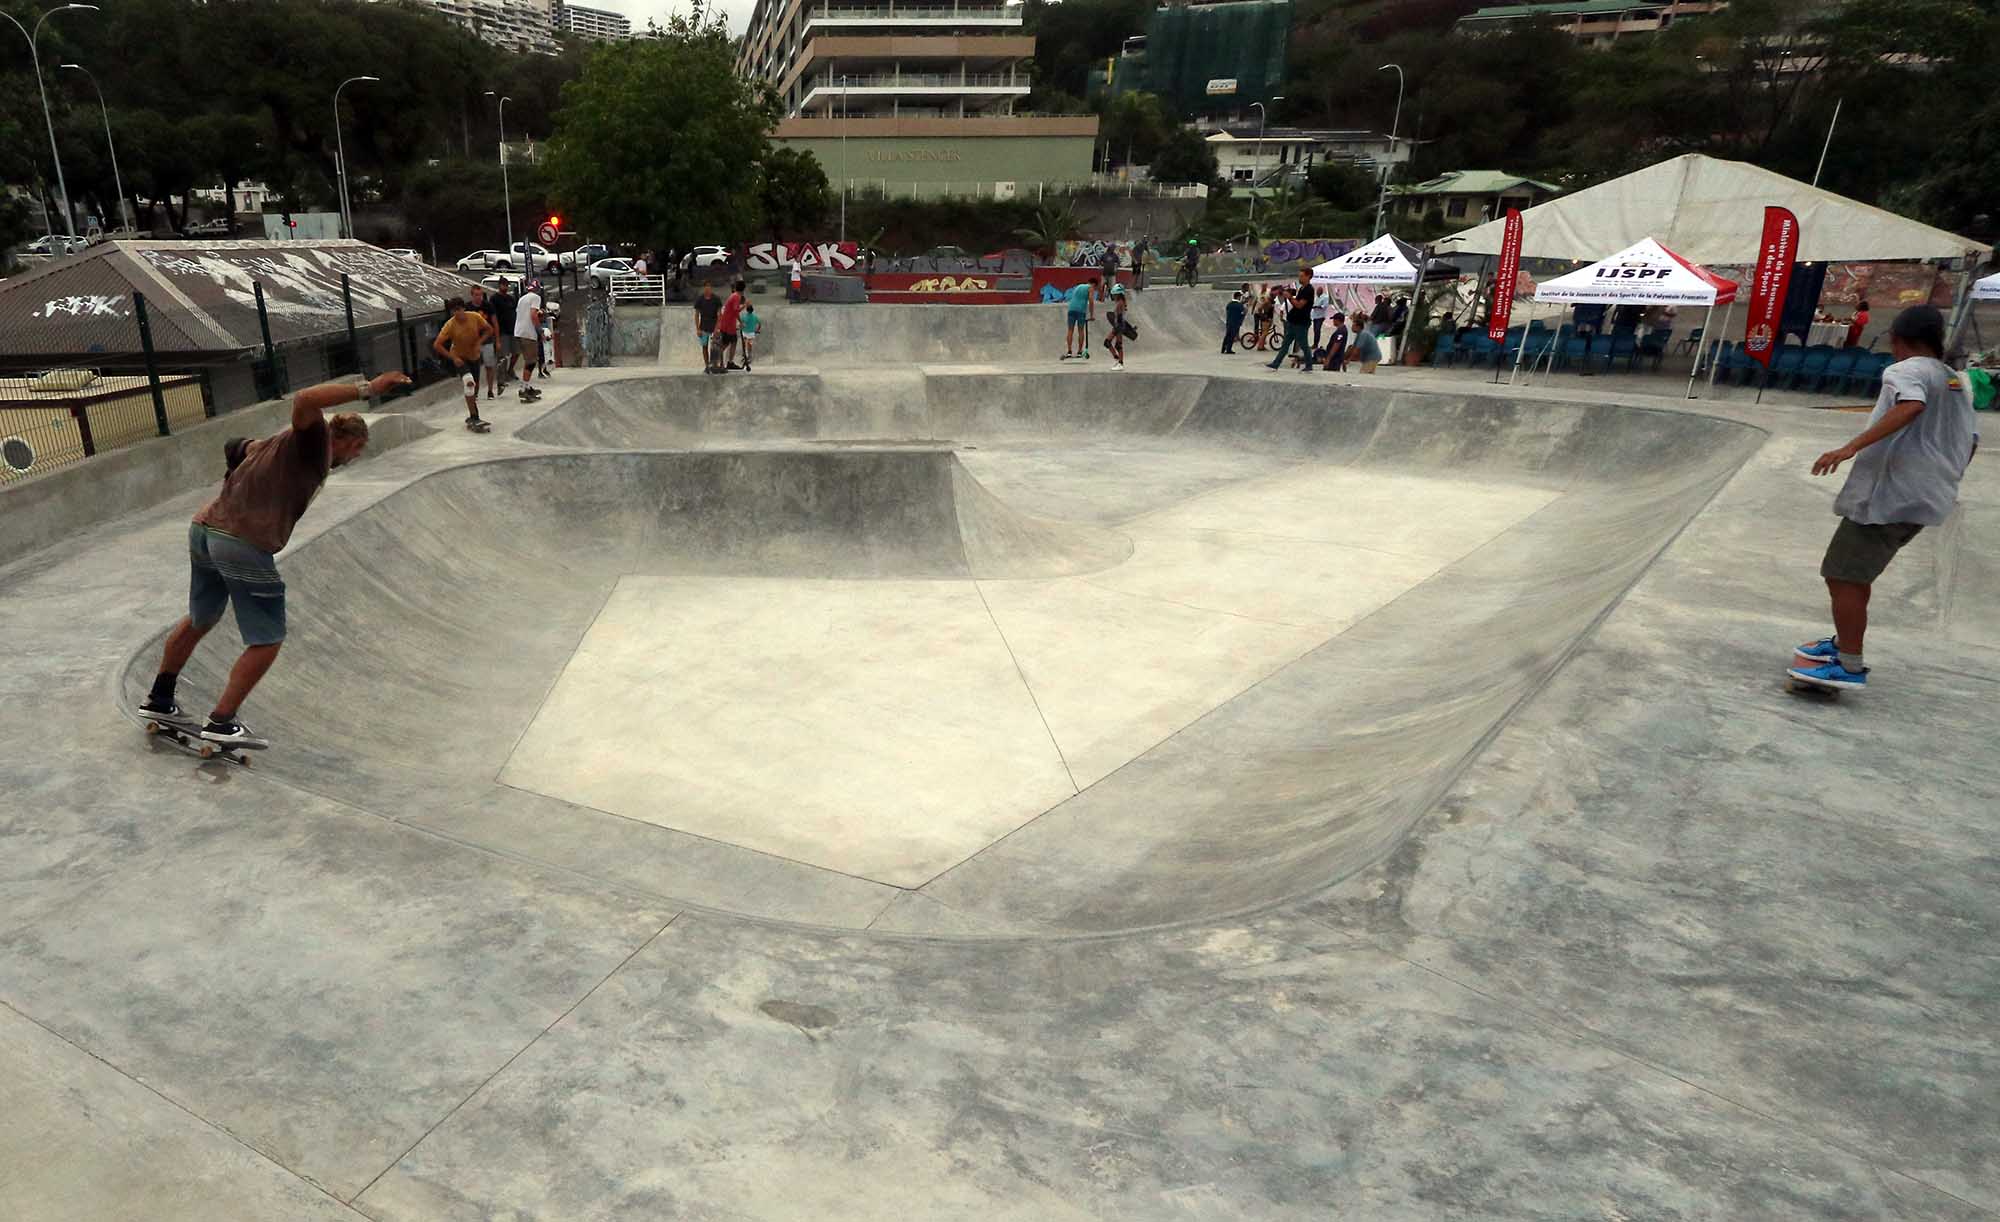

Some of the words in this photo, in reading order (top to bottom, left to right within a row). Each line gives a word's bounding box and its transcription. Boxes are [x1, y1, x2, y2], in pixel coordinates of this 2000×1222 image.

[1778, 219, 1791, 258] Ministère
[1768, 244, 1775, 252] et
[1345, 256, 1396, 264] IJSPF
[1765, 255, 1775, 269] des
[1776, 261, 1784, 271] de
[1596, 268, 1673, 279] IJSPF
[1773, 272, 1782, 281] la
[1759, 271, 1772, 296] Sports
[1765, 282, 1780, 320] Jeunesse
